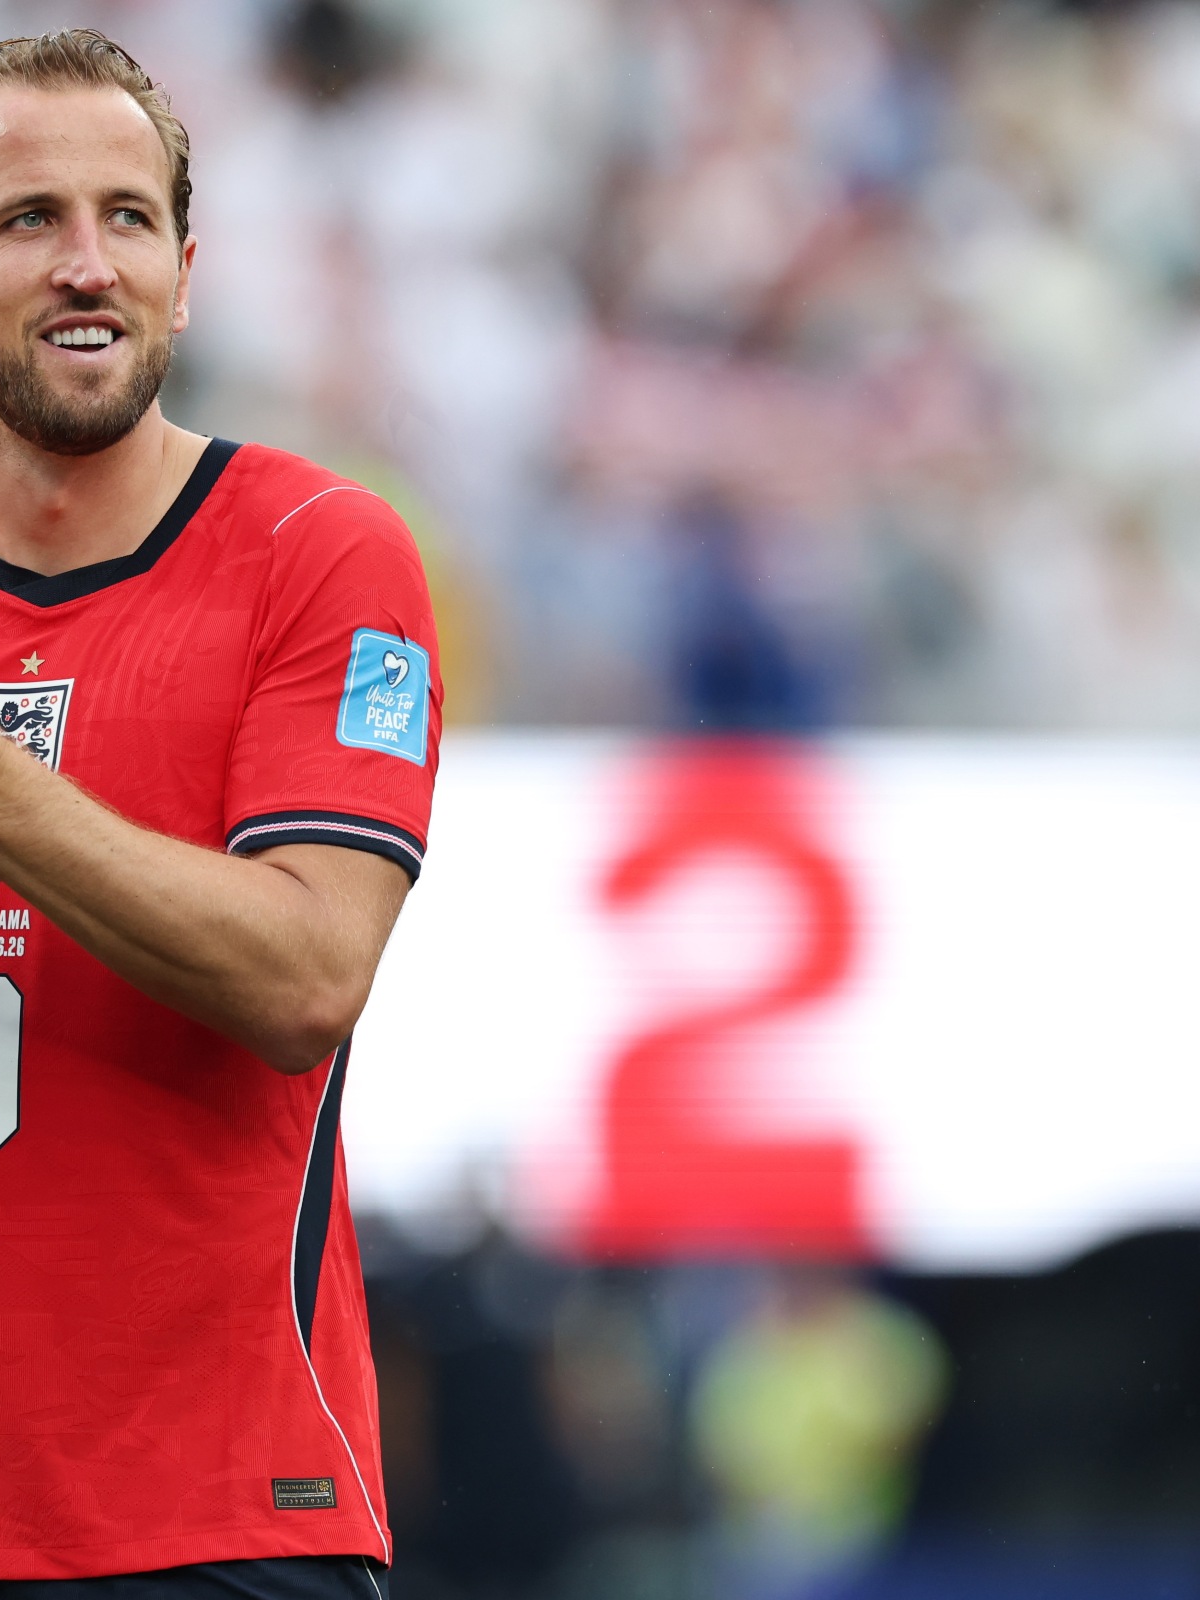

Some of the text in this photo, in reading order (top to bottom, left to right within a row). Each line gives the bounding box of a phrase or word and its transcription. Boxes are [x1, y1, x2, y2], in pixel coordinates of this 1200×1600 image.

[365, 684, 415, 711] Unite For
[365, 705, 411, 734] PEACE
[373, 730, 400, 743] FIFA
